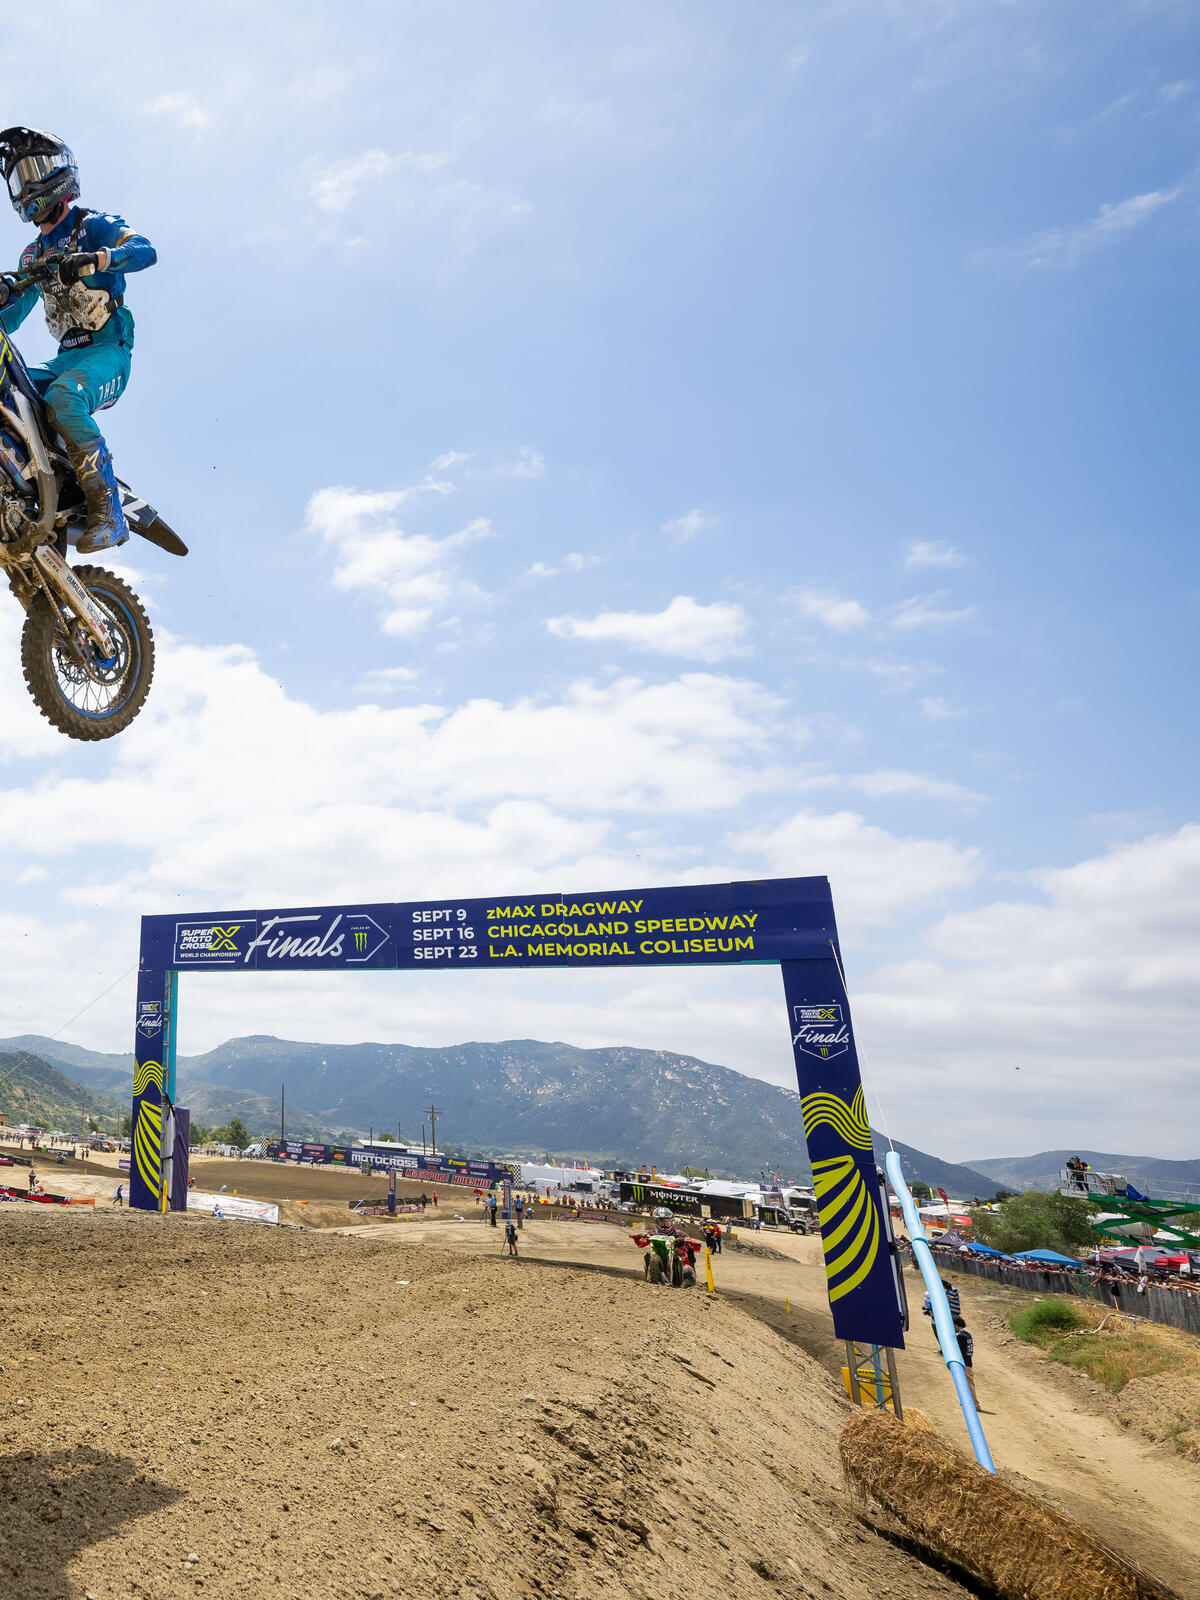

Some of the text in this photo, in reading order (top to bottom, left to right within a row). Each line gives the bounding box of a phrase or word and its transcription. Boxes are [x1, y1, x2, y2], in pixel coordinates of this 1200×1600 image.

[66, 573, 87, 601] YAMALUBE
[412, 908, 467, 923] SEPT 9
[486, 899, 644, 919] zMAX DRAGWAY
[180, 928, 215, 937] SUPER
[487, 913, 758, 938] CHICAGOLAND SPEEDWAY
[182, 935, 213, 943] MOTO
[244, 913, 345, 963] Finals
[413, 926, 475, 941] SEPT 16
[179, 942, 212, 950] CROSS
[413, 945, 478, 960] SEPT 23
[489, 935, 754, 958] L.A. MEMORIAL COLISEUM
[136, 1013, 163, 1028] Finals
[792, 1024, 850, 1045] Finals
[351, 1153, 418, 1168] MOTOCROSS
[452, 1175, 492, 1189] HOLESHOT
[650, 1190, 699, 1205] MONSTER
